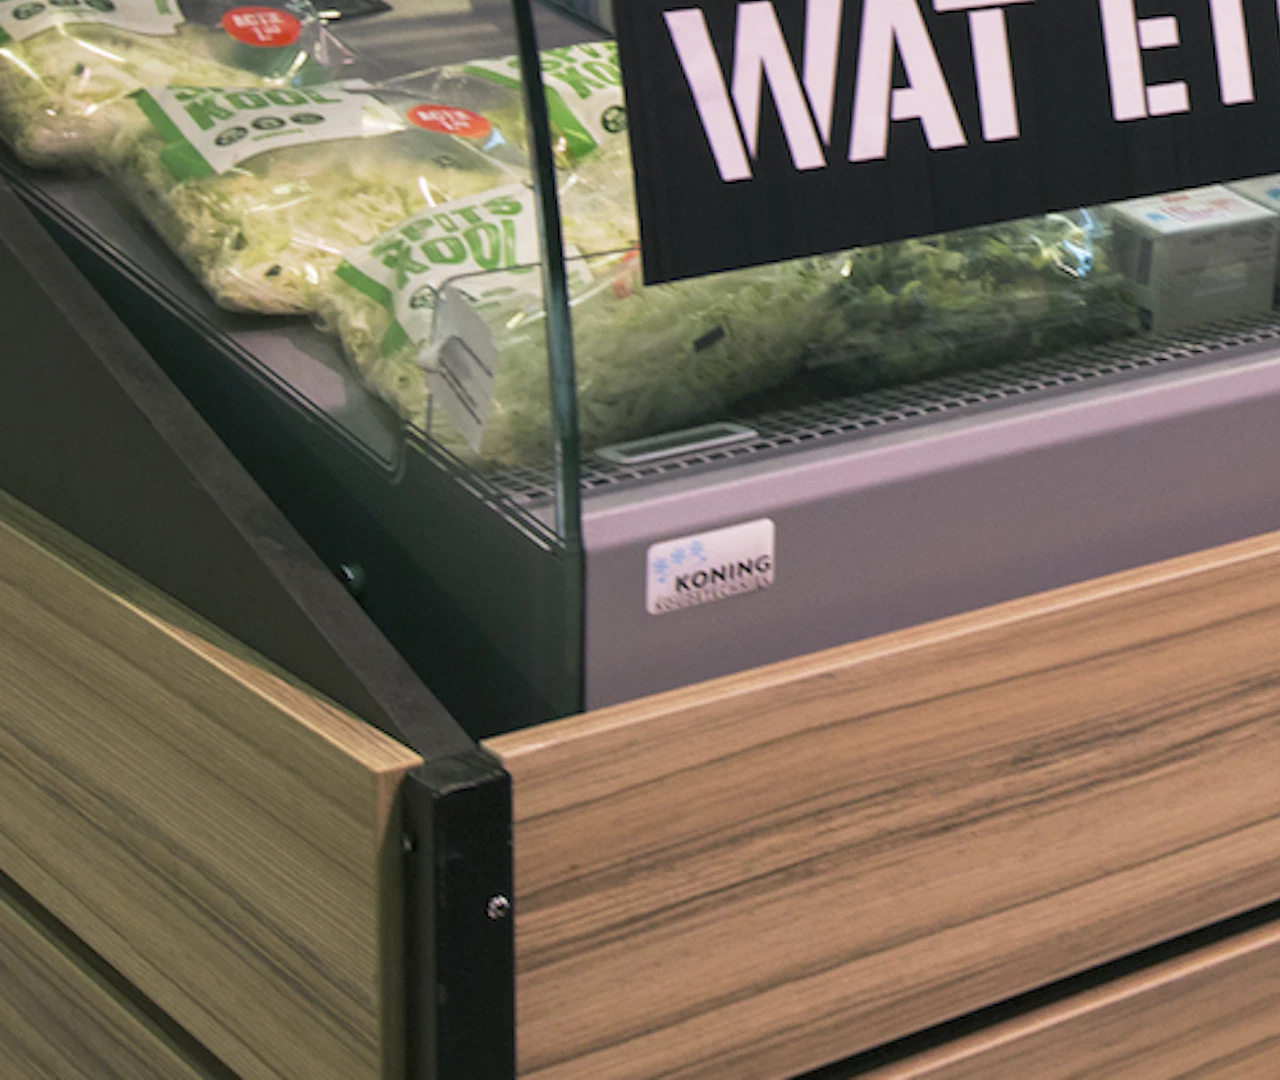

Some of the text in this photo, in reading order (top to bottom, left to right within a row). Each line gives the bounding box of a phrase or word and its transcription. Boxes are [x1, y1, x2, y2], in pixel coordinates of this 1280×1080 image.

[183, 86, 343, 131] KOOL
[381, 219, 534, 290] KOOL
[674, 554, 772, 593] KONING
